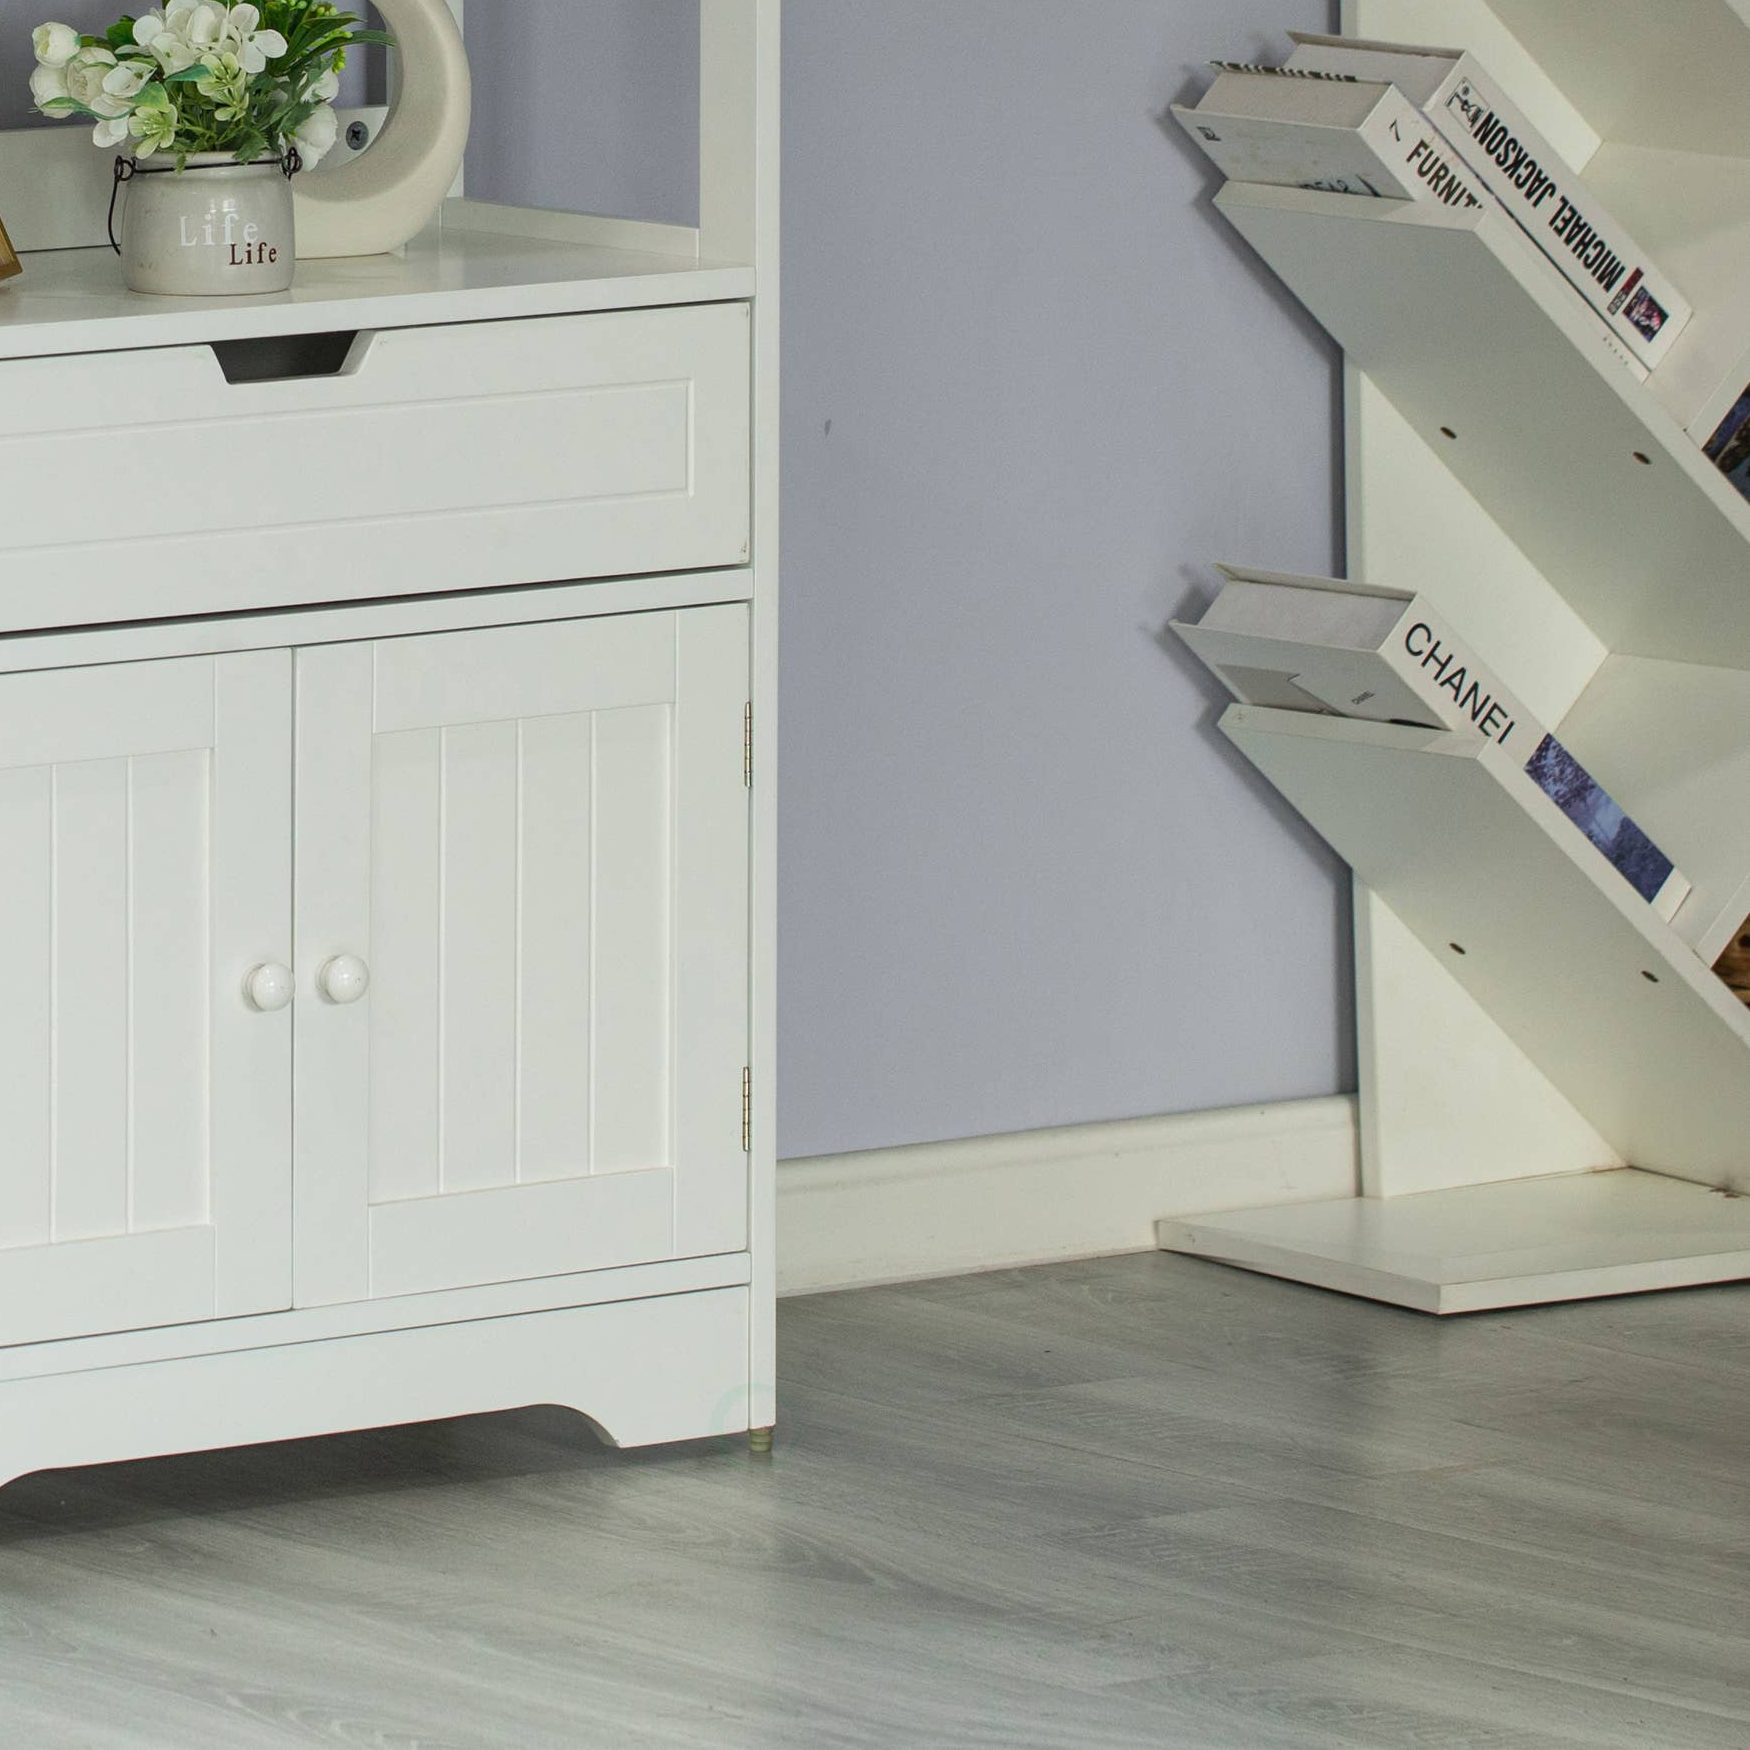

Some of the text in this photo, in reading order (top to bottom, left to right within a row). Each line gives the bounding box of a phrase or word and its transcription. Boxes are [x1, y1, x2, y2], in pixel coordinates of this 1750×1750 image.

[1473, 111, 1626, 293] MICHAEL JACKSON
[180, 213, 259, 247] Life
[230, 242, 277, 266] Life
